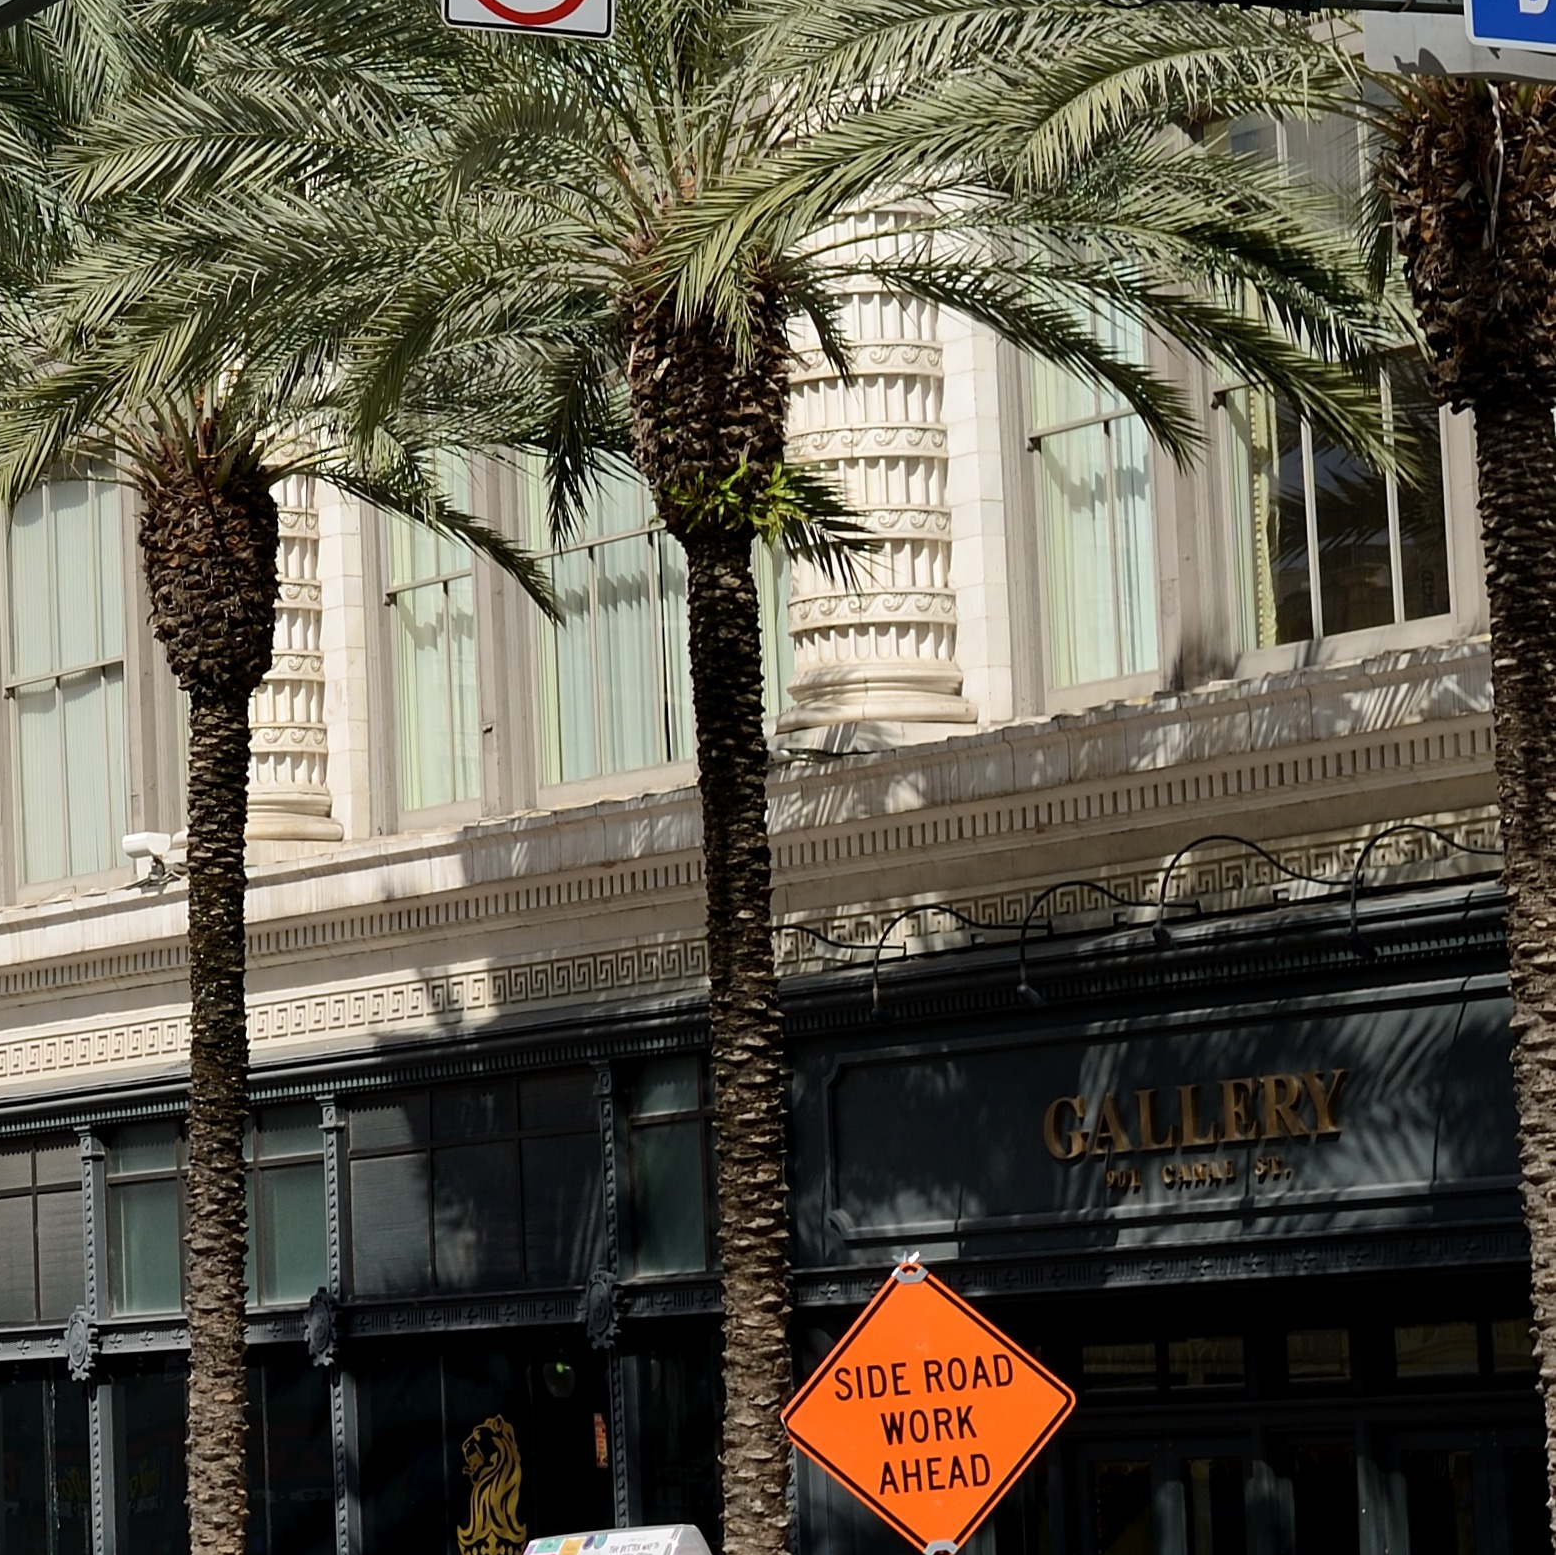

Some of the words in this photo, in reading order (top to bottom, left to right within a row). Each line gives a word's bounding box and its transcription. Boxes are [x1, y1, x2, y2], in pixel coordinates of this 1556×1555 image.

[1043, 1068, 1352, 1161] GALLERY
[1105, 1169, 1141, 1189] 901
[1161, 1158, 1237, 1186] CANAL
[834, 1362, 911, 1401] SIDE
[923, 1354, 1013, 1394] ROAD
[880, 1405, 977, 1446] WORK
[879, 1453, 991, 1495] AHEAD
